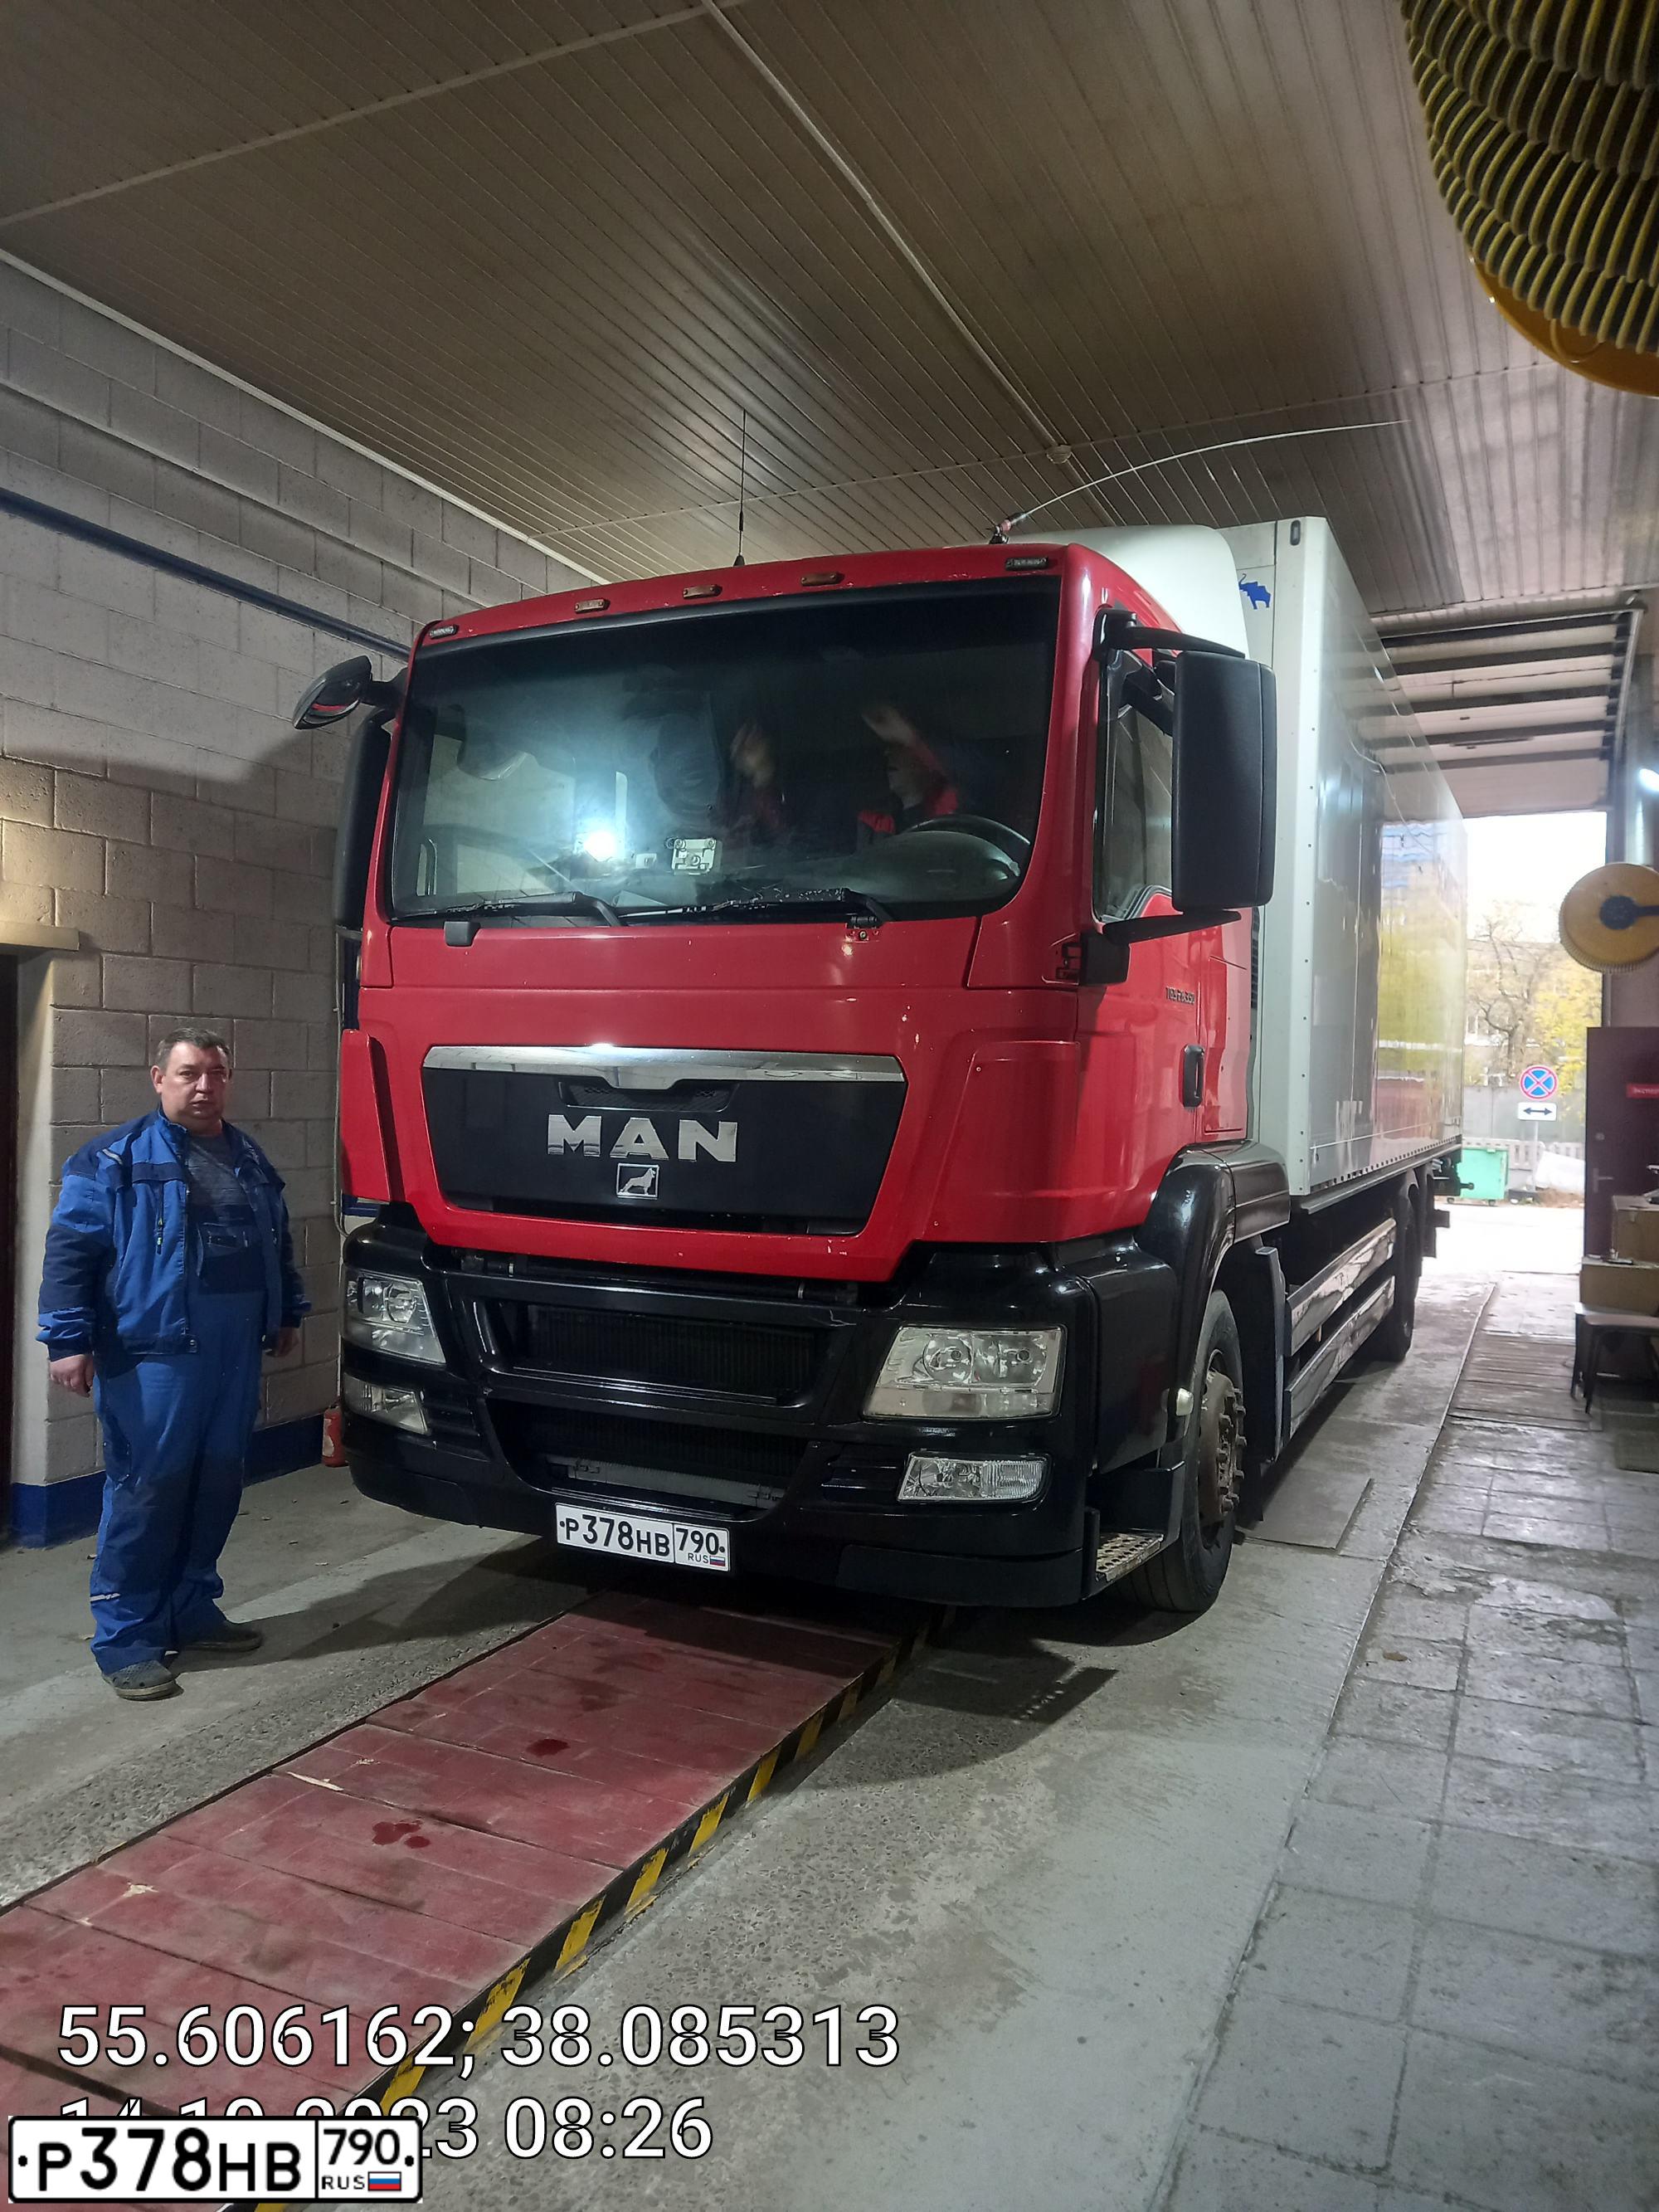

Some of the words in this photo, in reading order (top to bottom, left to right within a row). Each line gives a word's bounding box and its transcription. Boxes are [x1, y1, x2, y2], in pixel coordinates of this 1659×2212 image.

[547, 1113, 738, 1162] MAN
[674, 1527, 720, 1556] 790
[687, 1552, 708, 1564] RUS
